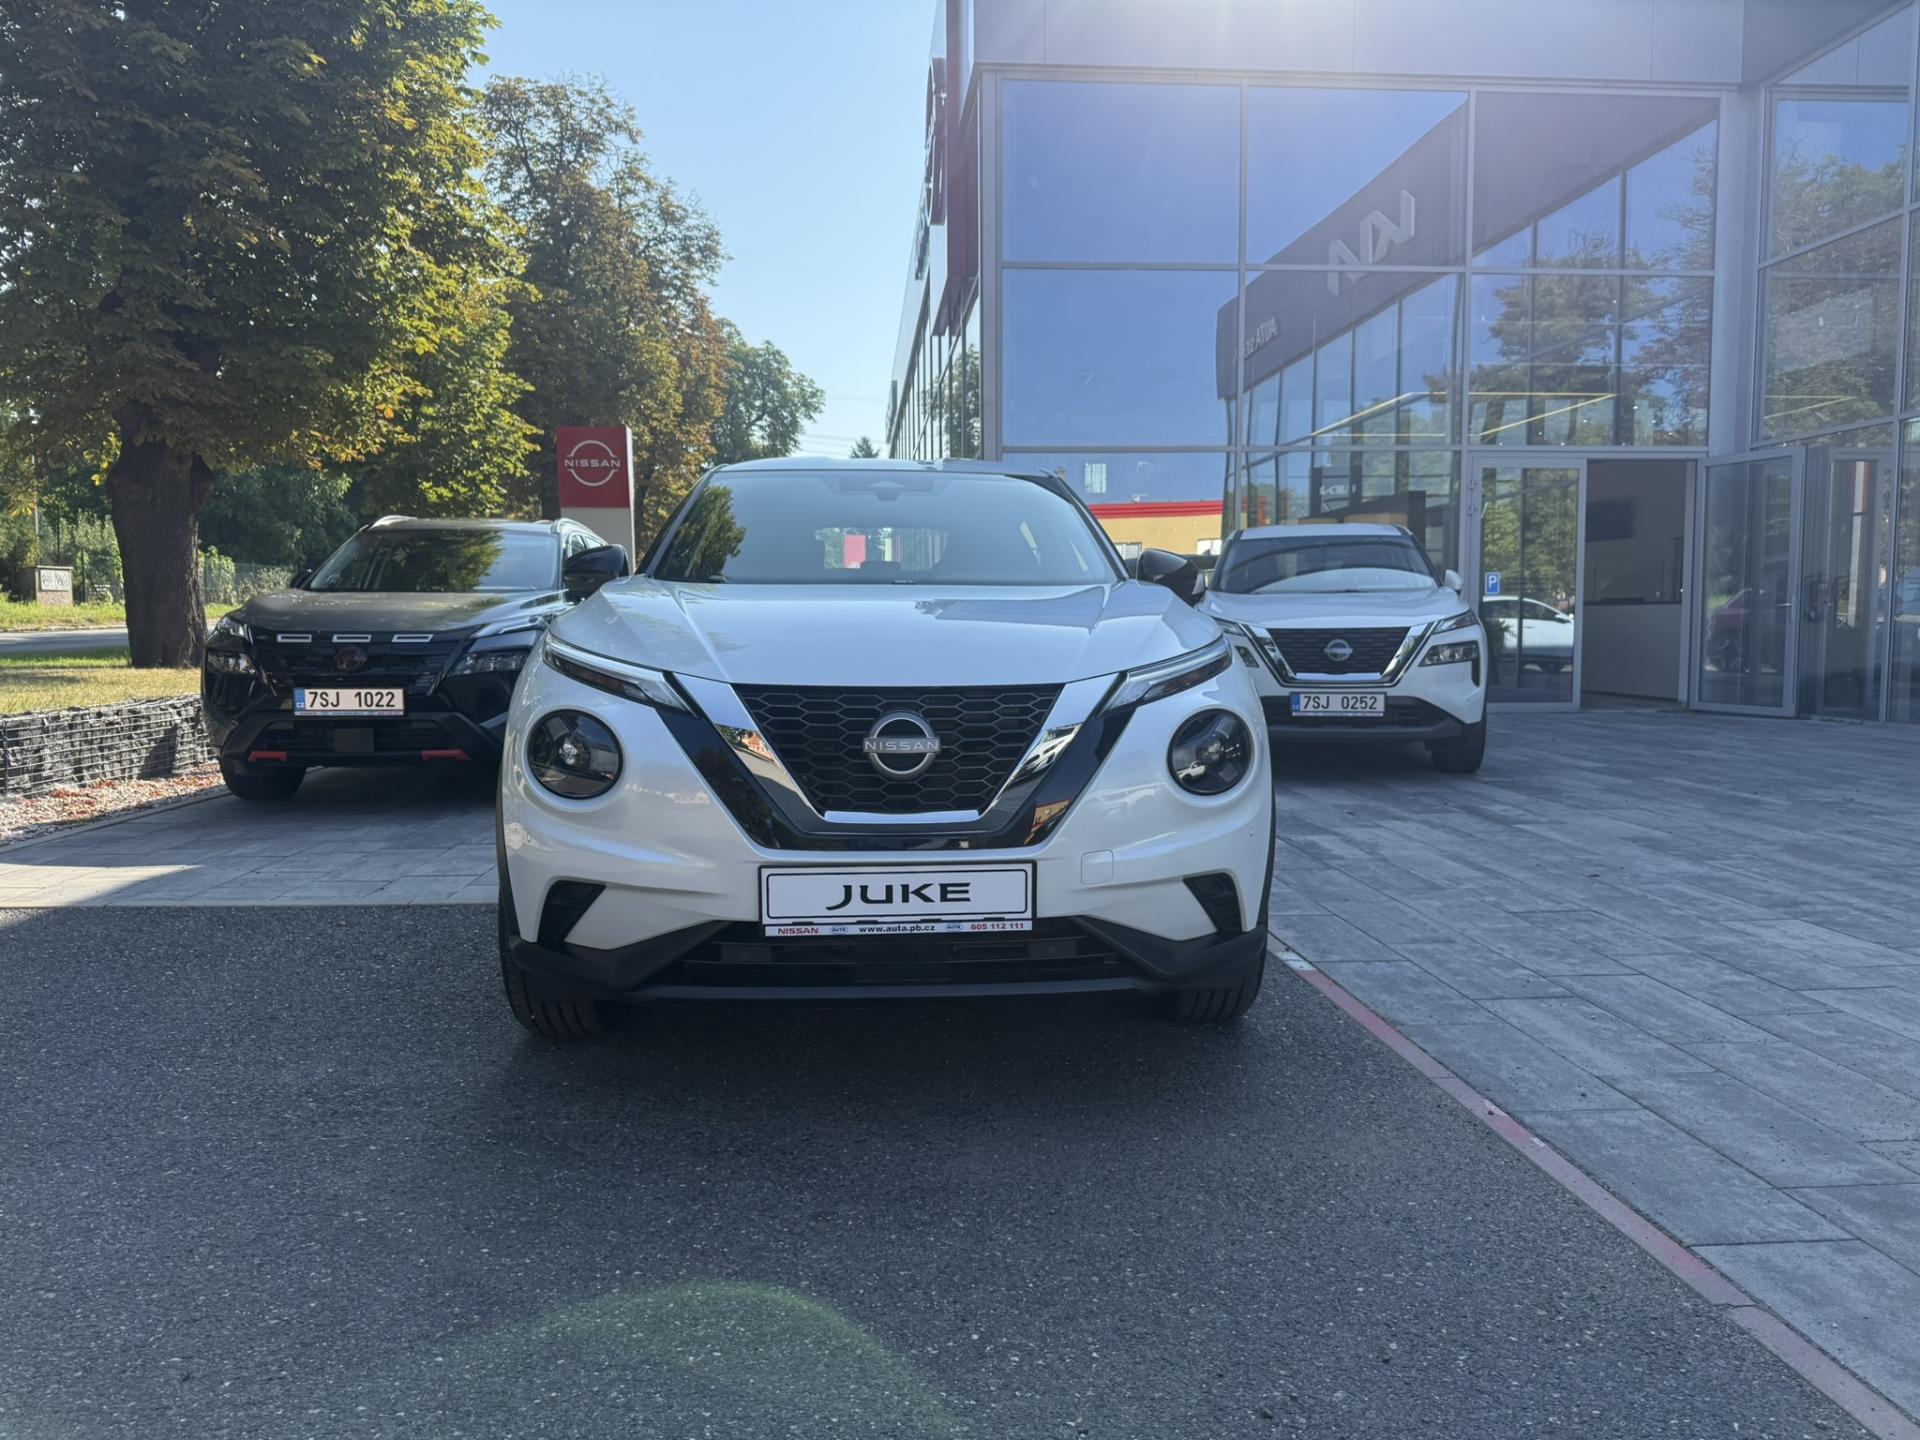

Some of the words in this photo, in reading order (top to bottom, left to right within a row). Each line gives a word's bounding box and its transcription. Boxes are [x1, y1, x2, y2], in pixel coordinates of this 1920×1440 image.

[564, 459, 621, 468] NISSAN
[1488, 575, 1497, 588] P
[308, 691, 340, 708] 7SJ
[354, 691, 395, 708] 1022
[1303, 695, 1330, 710] 7SJ
[1341, 695, 1377, 710] 0252
[863, 740, 939, 751] NISSAN
[825, 882, 971, 911] JUKE
[777, 927, 819, 935] NISSAN
[859, 924, 935, 933] www.auta.pb.cz
[990, 922, 1006, 930] 112
